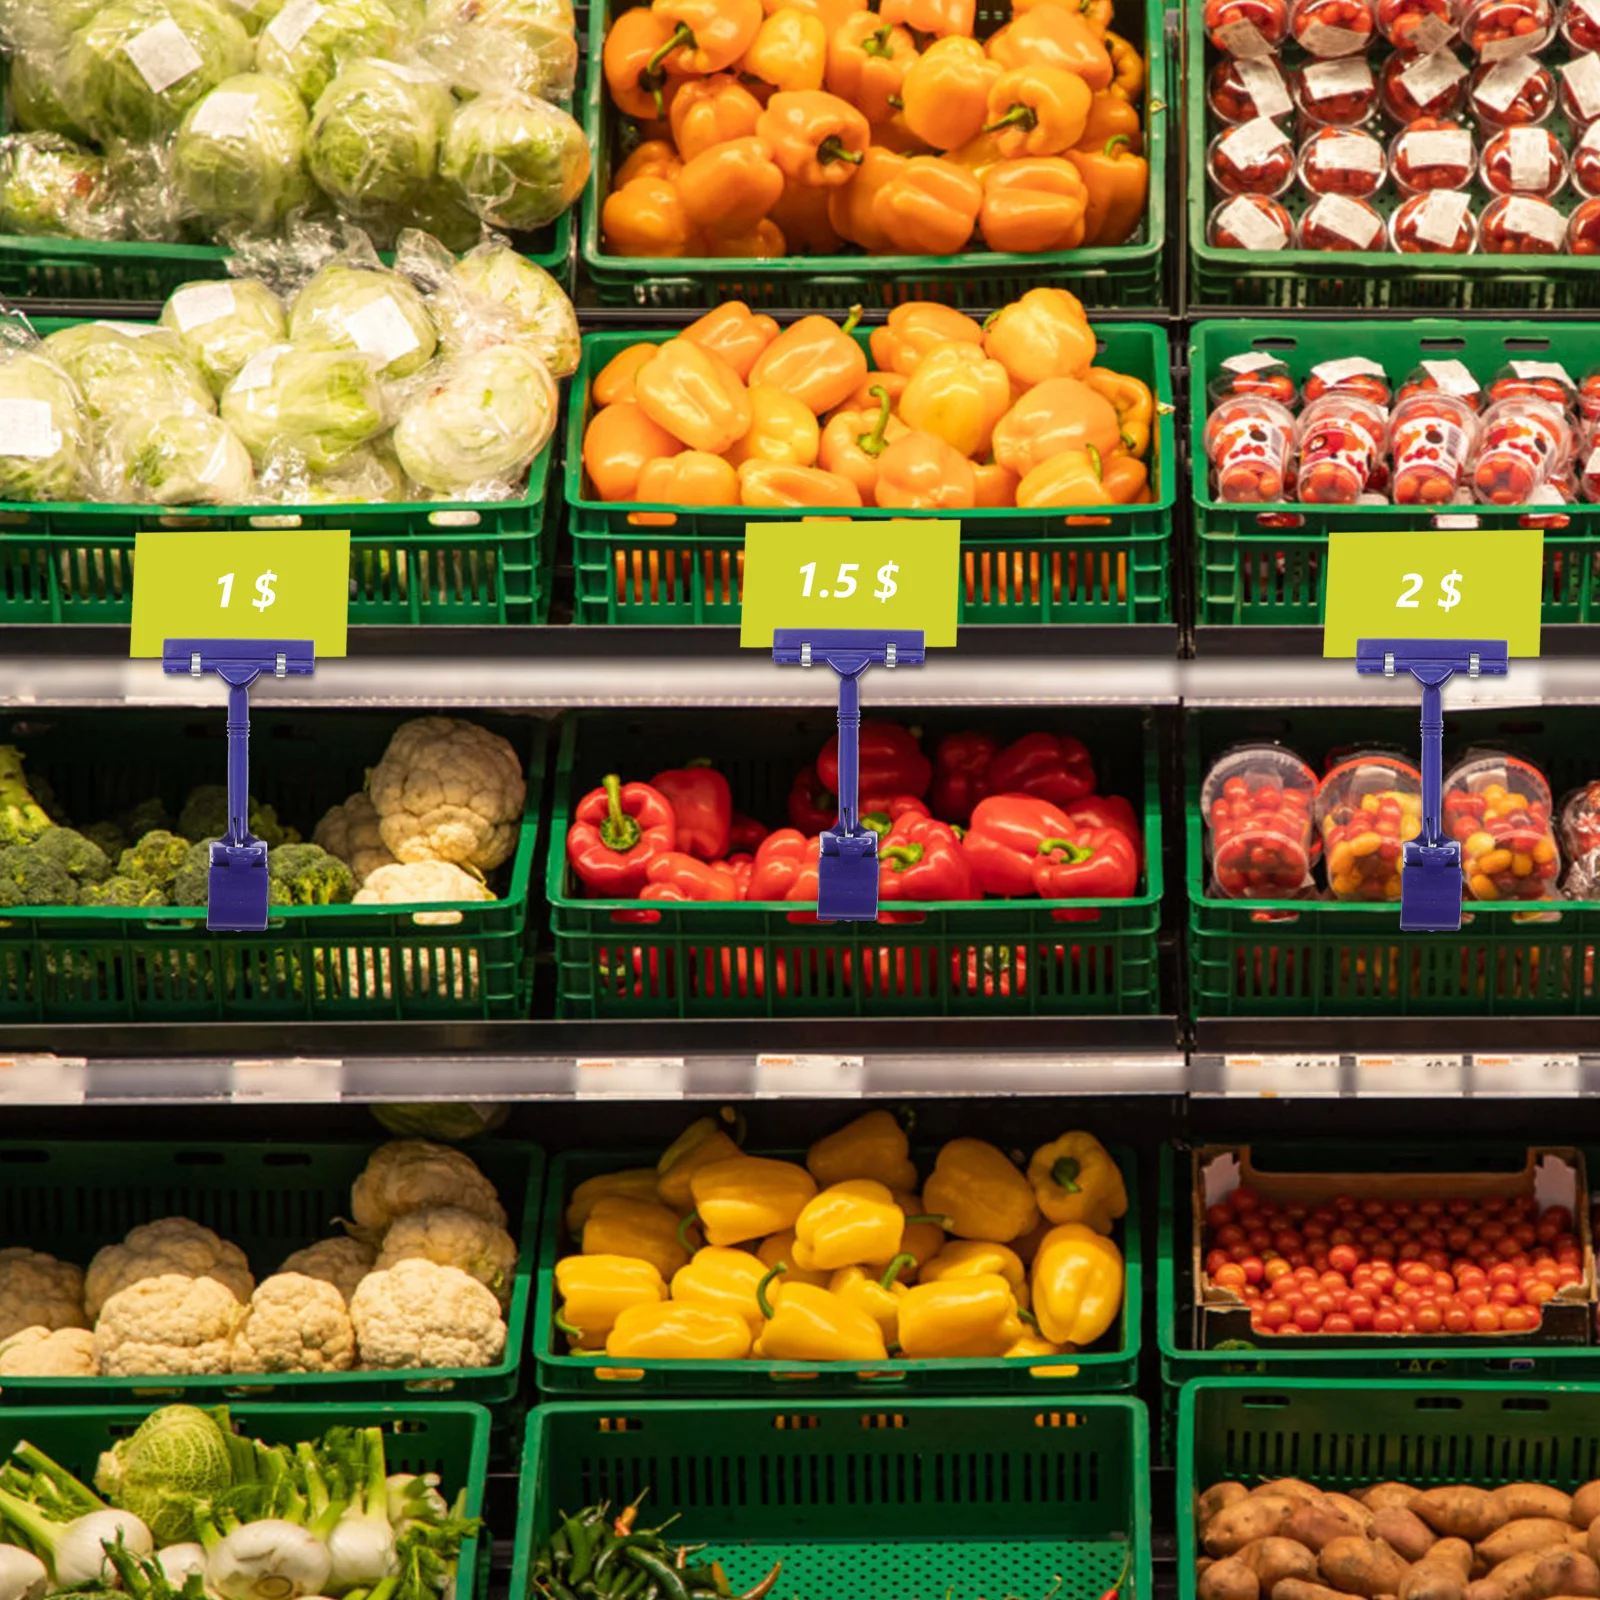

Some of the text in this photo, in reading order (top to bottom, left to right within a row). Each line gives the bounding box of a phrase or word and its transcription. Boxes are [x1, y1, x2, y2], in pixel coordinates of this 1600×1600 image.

[217, 569, 278, 613] 1 $
[799, 559, 900, 604] 1.5 $
[1395, 569, 1463, 613] 2 $
